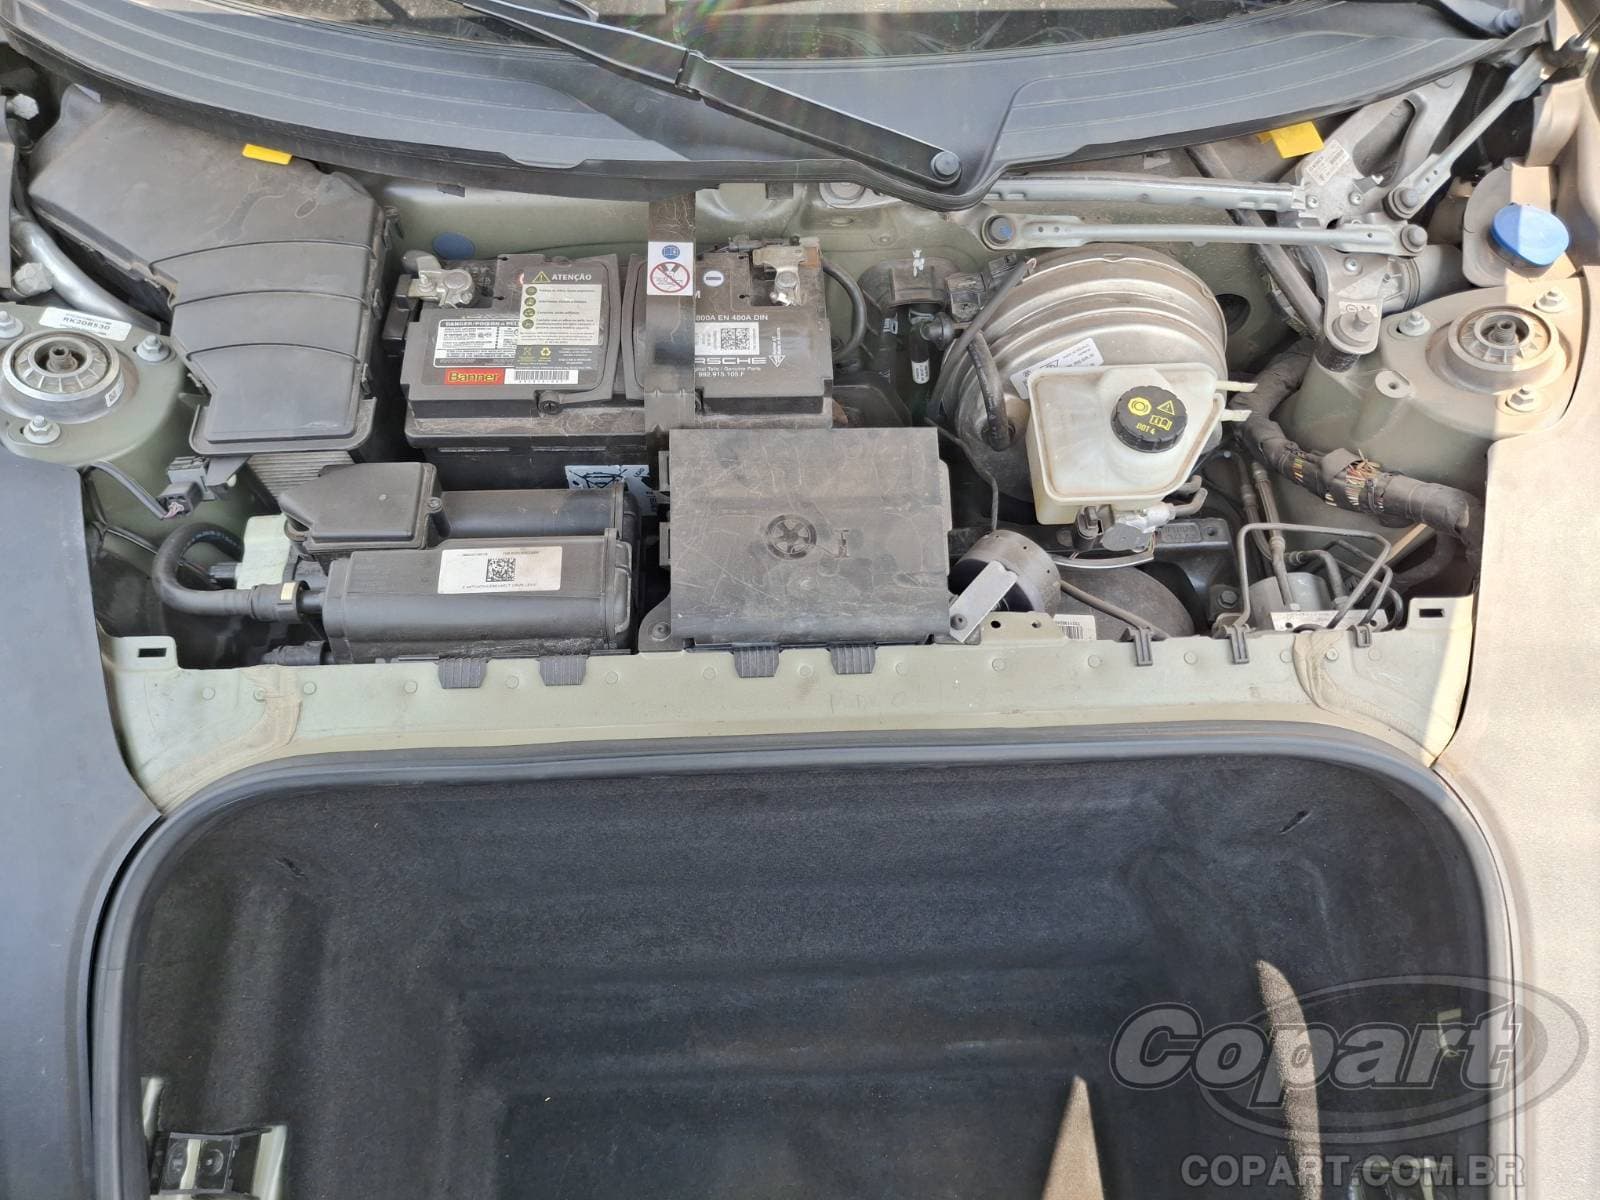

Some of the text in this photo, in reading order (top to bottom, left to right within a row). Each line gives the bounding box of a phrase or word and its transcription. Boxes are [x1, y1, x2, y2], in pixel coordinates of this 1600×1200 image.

[551, 273, 592, 282] ATENÇÃO
[694, 357, 767, 365] RSCHE
[448, 371, 497, 382] Banner
